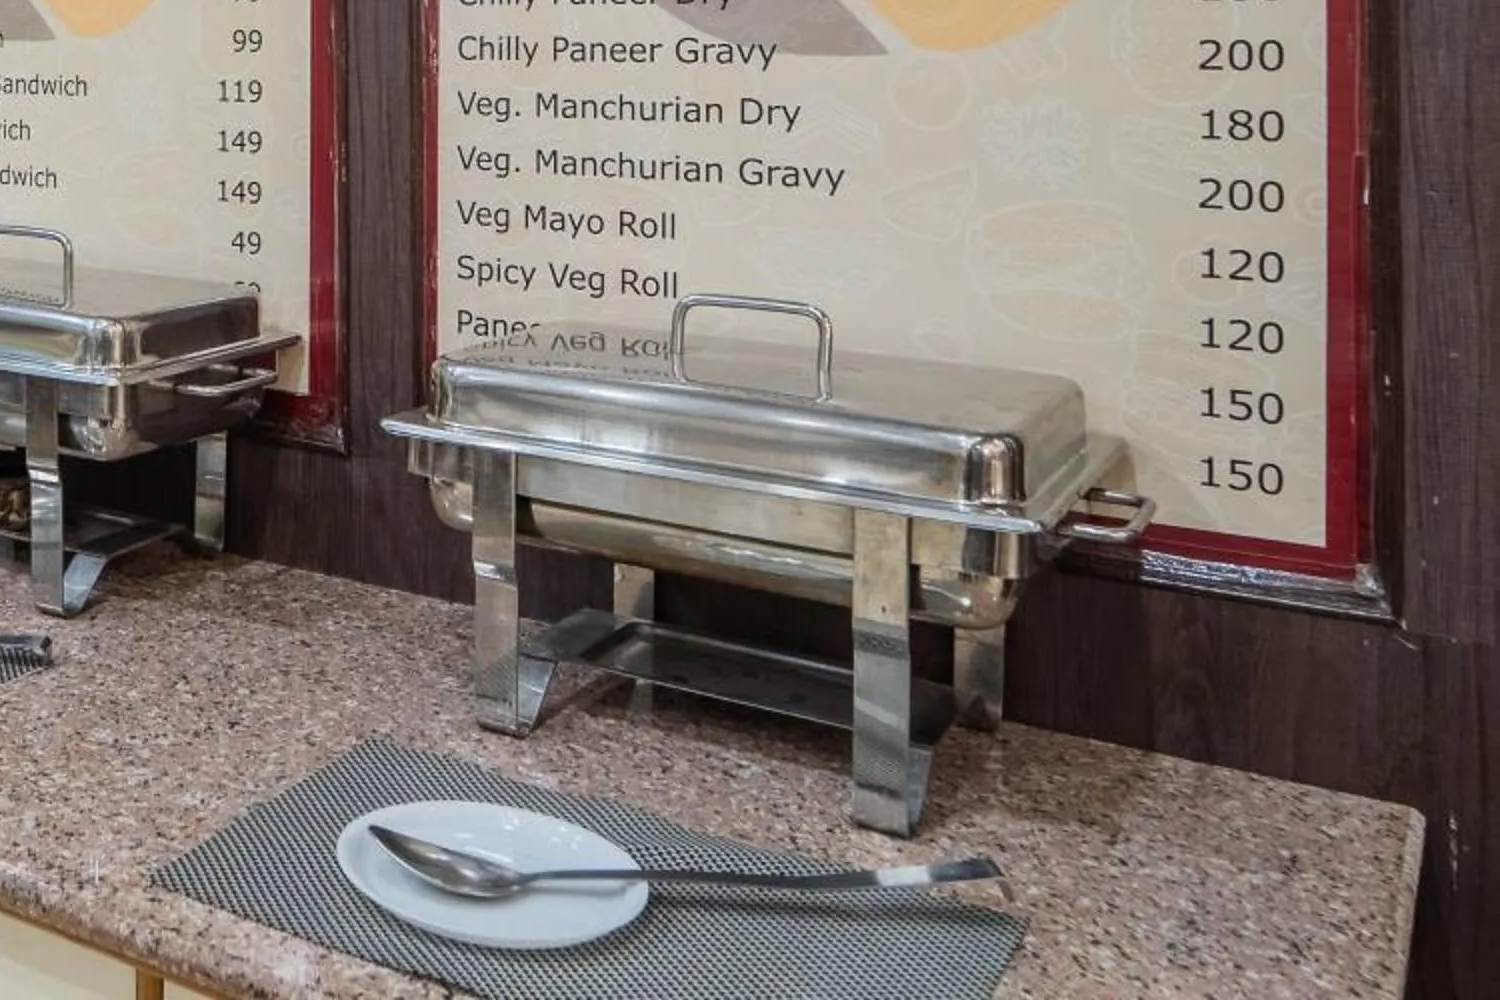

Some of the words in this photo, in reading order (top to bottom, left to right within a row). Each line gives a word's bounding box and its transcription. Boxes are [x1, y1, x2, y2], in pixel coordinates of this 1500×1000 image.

[232, 29, 262, 52] 99
[457, 91, 520, 122] Veg.
[536, 92, 722, 123] Manchurian
[740, 97, 800, 132] Dry
[1201, 109, 1283, 141] 180
[218, 180, 261, 204] 149
[231, 231, 260, 254] 49
[457, 254, 536, 290] Spicy
[548, 262, 604, 298] Veg
[621, 268, 676, 298] Roll
[1201, 317, 1283, 354] 120
[1201, 387, 1283, 424] 150
[1200, 456, 1284, 495] 150
